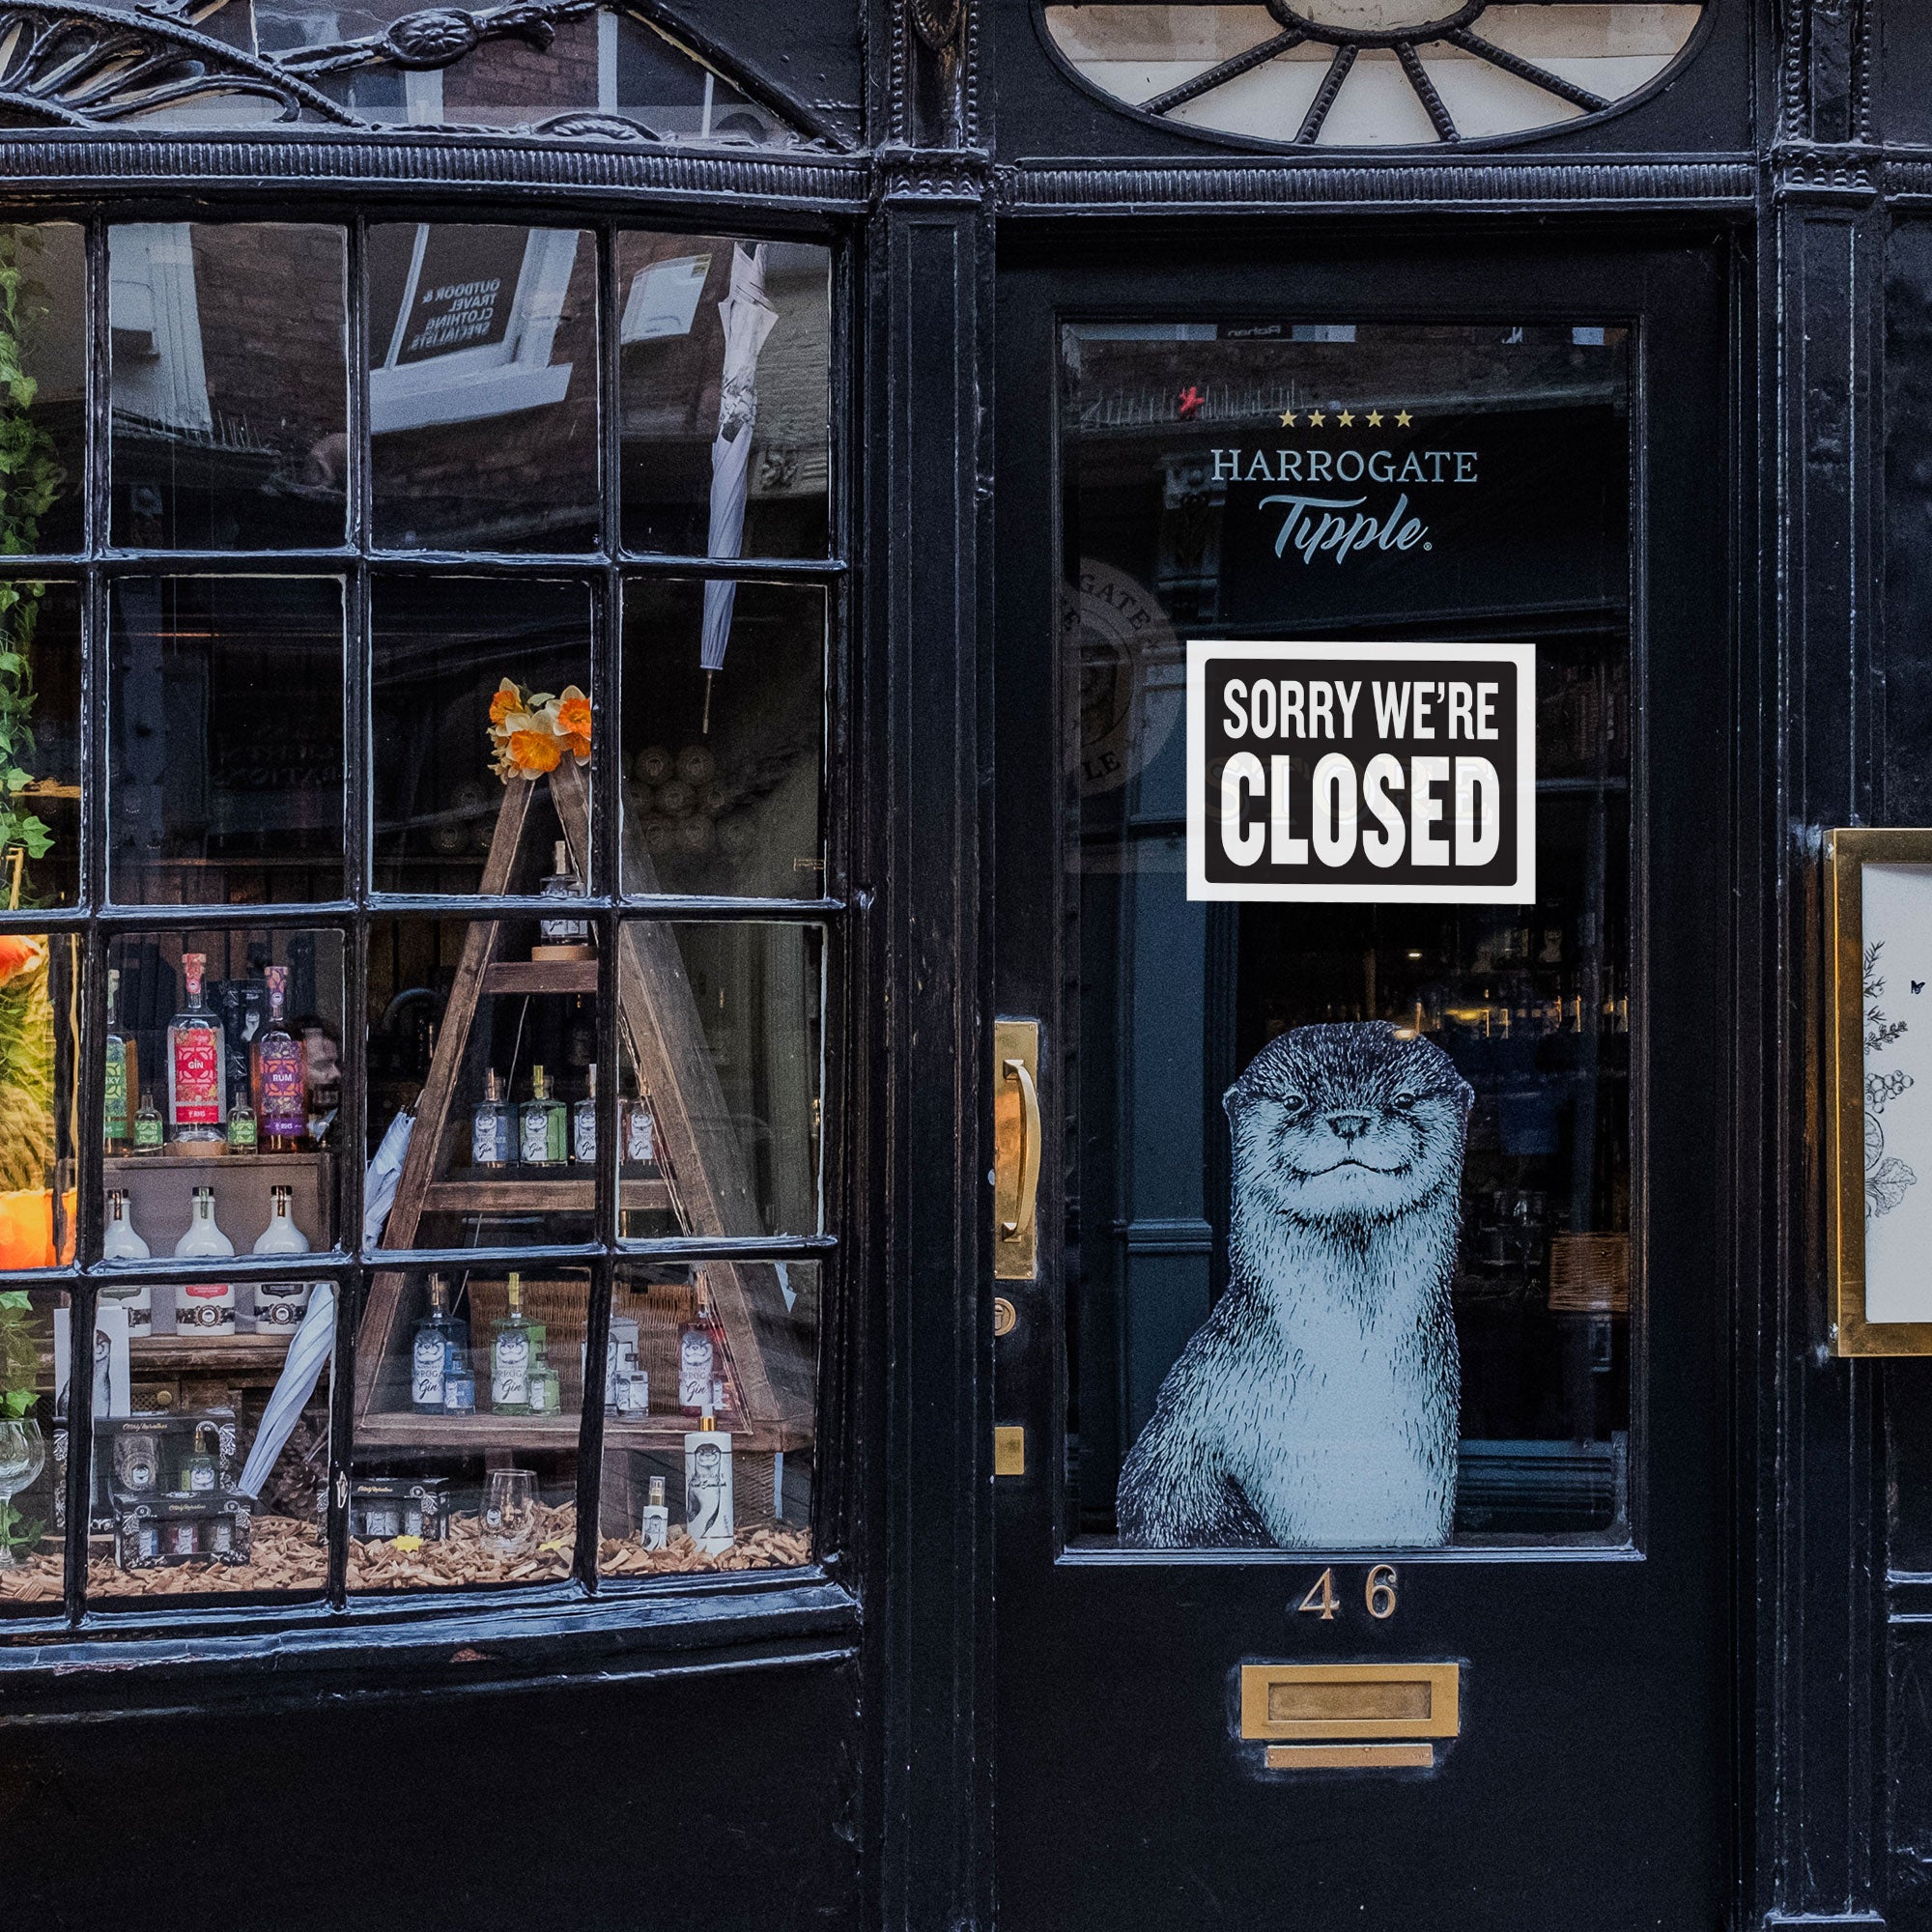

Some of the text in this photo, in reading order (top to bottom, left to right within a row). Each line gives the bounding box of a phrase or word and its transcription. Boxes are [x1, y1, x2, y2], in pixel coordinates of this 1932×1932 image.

[1210, 448, 1478, 483] HARROGATE
[1223, 678, 1499, 741] SORRY WE'RE
[1221, 751, 1500, 868] CLOSED
[187, 1058, 204, 1069] GIN
[272, 1073, 293, 1083] RUM
[418, 1378, 439, 1400] Gin
[501, 1378, 523, 1400] Gin
[686, 1380, 706, 1402] Gin
